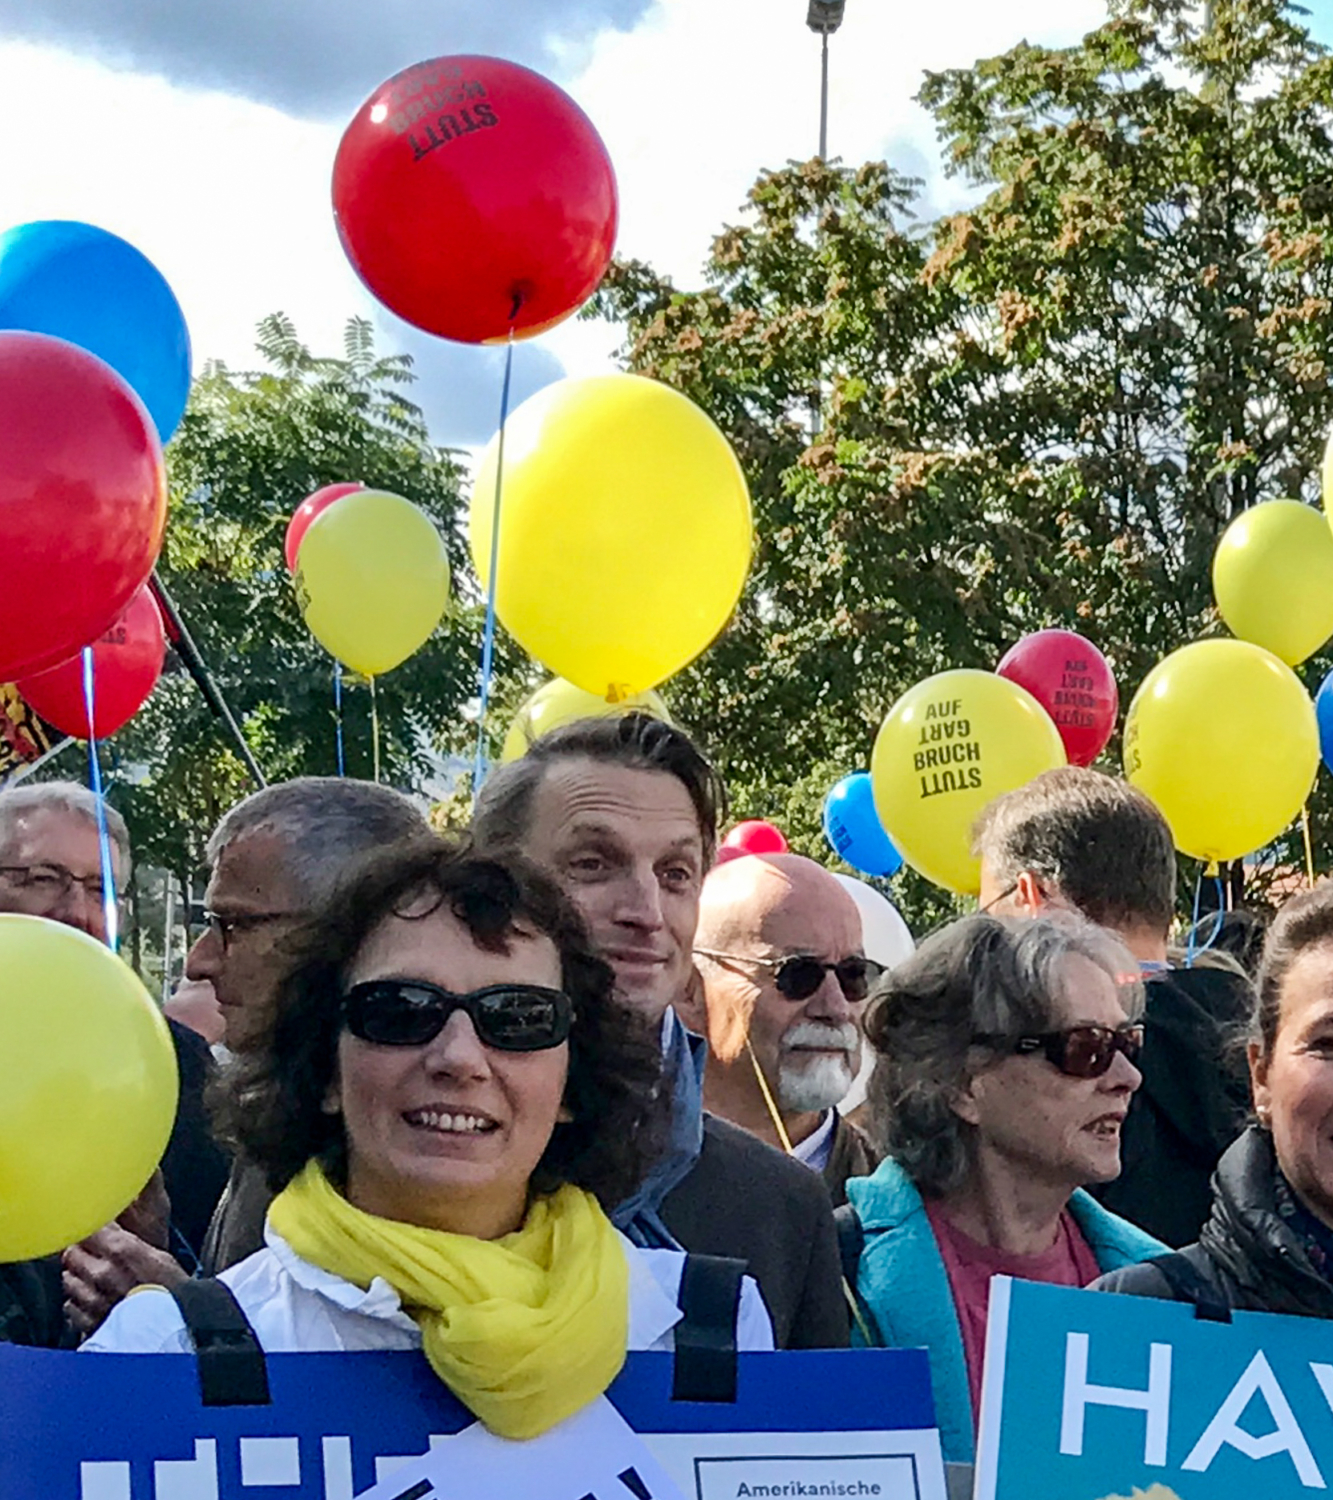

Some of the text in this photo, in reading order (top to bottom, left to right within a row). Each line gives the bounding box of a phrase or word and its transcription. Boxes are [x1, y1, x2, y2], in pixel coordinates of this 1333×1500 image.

[387, 79, 487, 135] BRUCH
[406, 102, 499, 163] STUTT
[925, 699, 962, 720] AUF
[918, 719, 971, 745] GART
[914, 742, 981, 771] BRUCH
[920, 767, 982, 799] STUTT
[736, 1481, 882, 1498] Amerikanische
